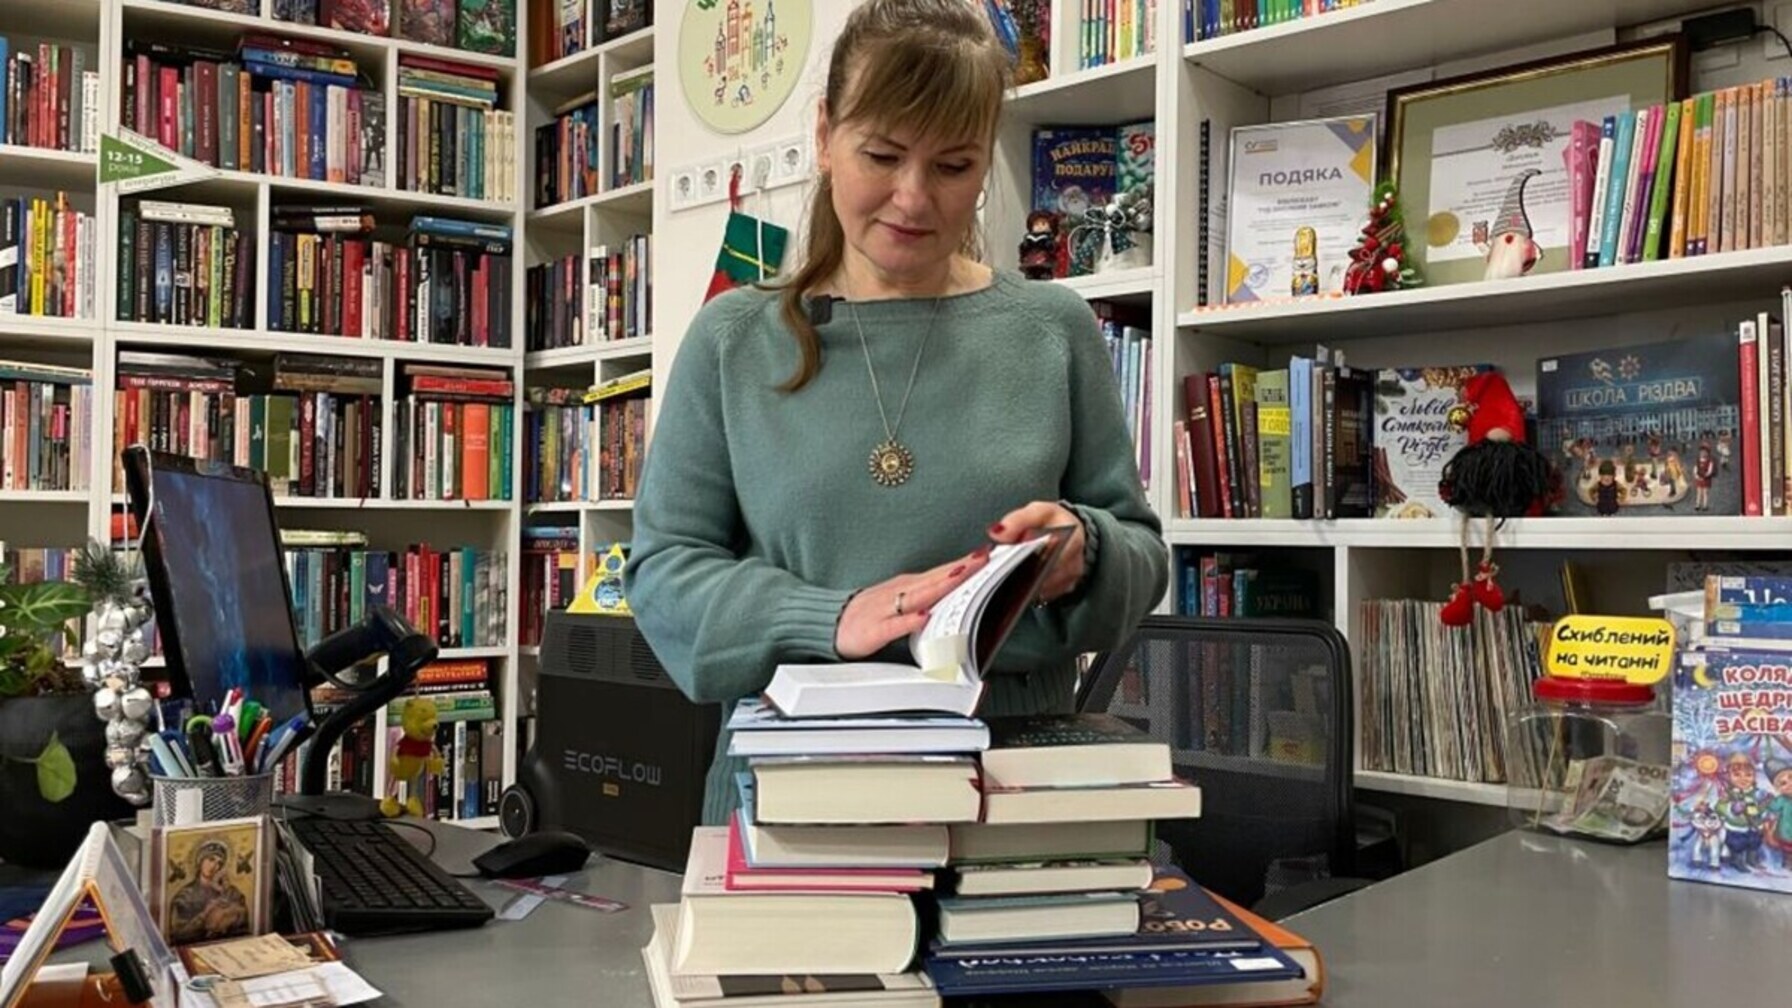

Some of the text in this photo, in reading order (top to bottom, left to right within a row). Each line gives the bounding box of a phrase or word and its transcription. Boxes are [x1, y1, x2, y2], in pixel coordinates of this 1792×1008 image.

[107, 150, 143, 164] 12-15
[1049, 138, 1115, 161] НАЙКРА
[1055, 163, 1115, 176] ПОДАРУ
[1259, 167, 1343, 186] ПОДЯКА
[1566, 380, 1698, 409] ШКОЛА РІЗДВА
[1400, 397, 1456, 415] Львів
[1556, 624, 1672, 648] Схиблений
[1556, 652, 1661, 671] на читанні
[564, 749, 661, 786] ECOFLOW
